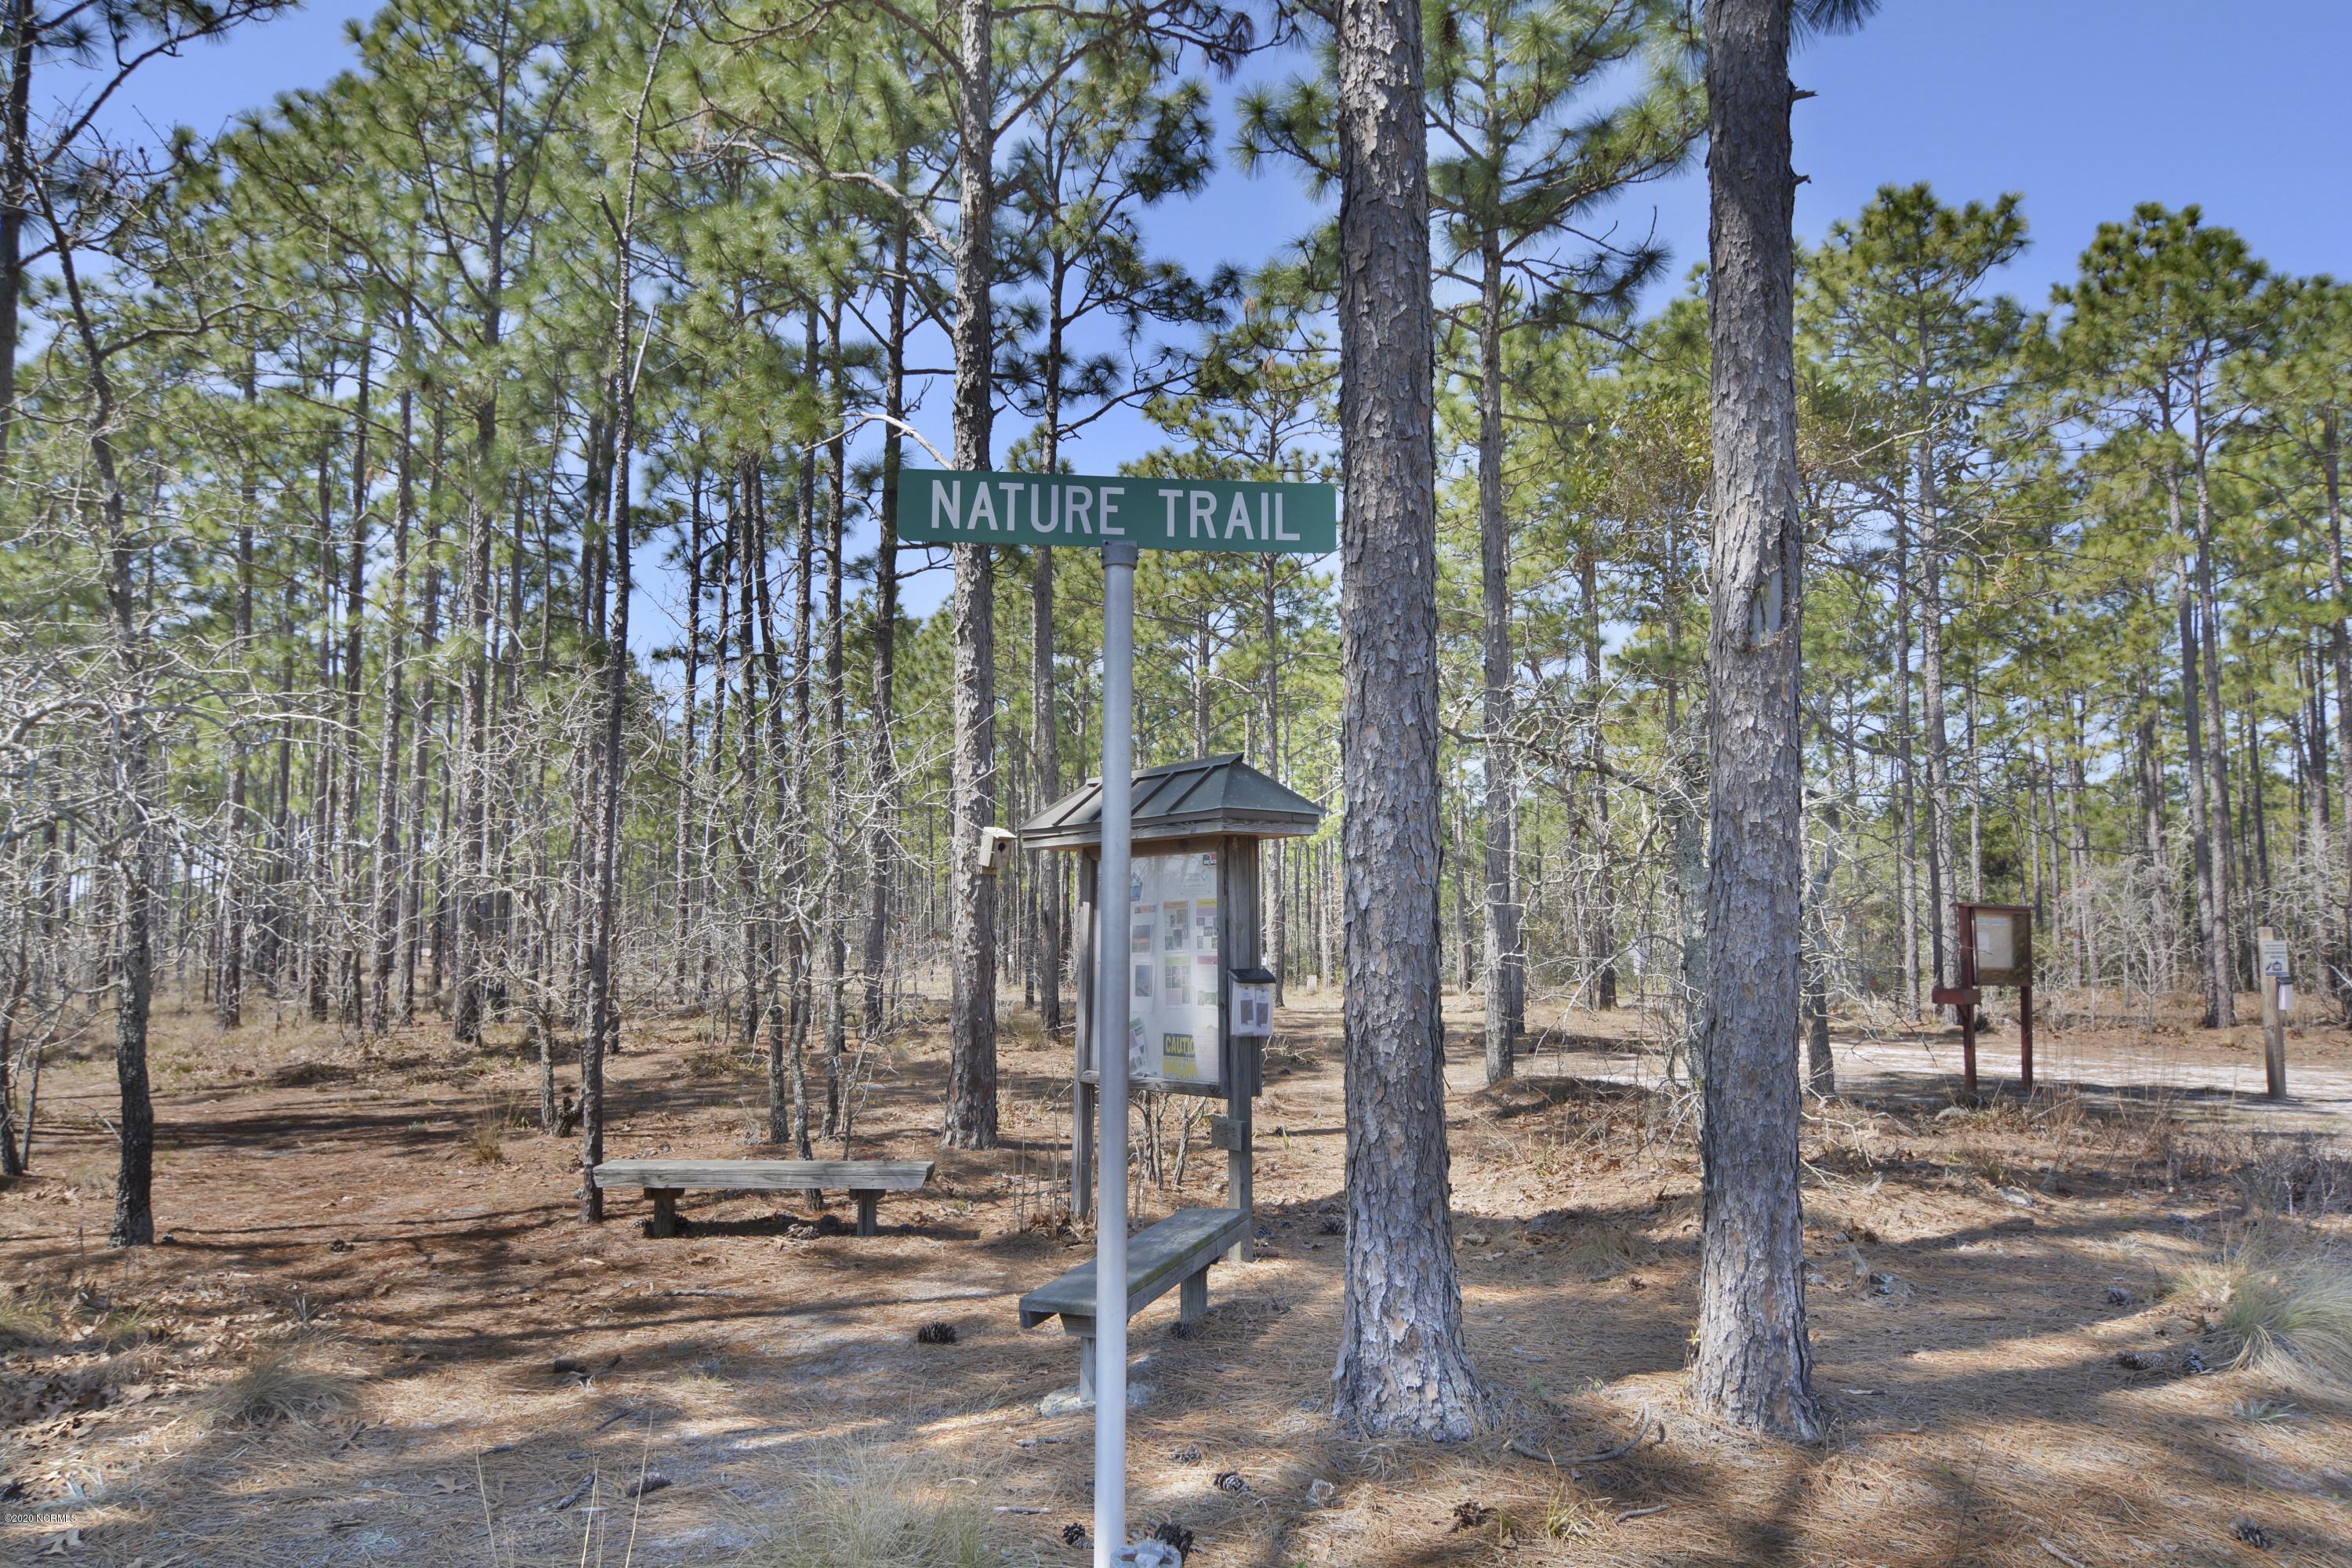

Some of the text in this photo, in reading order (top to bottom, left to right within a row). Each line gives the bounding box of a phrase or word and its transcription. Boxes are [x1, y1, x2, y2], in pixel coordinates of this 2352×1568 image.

[931, 480, 1301, 540] NATURE TRAIL
[1166, 1035, 1195, 1054] CAUTIO
